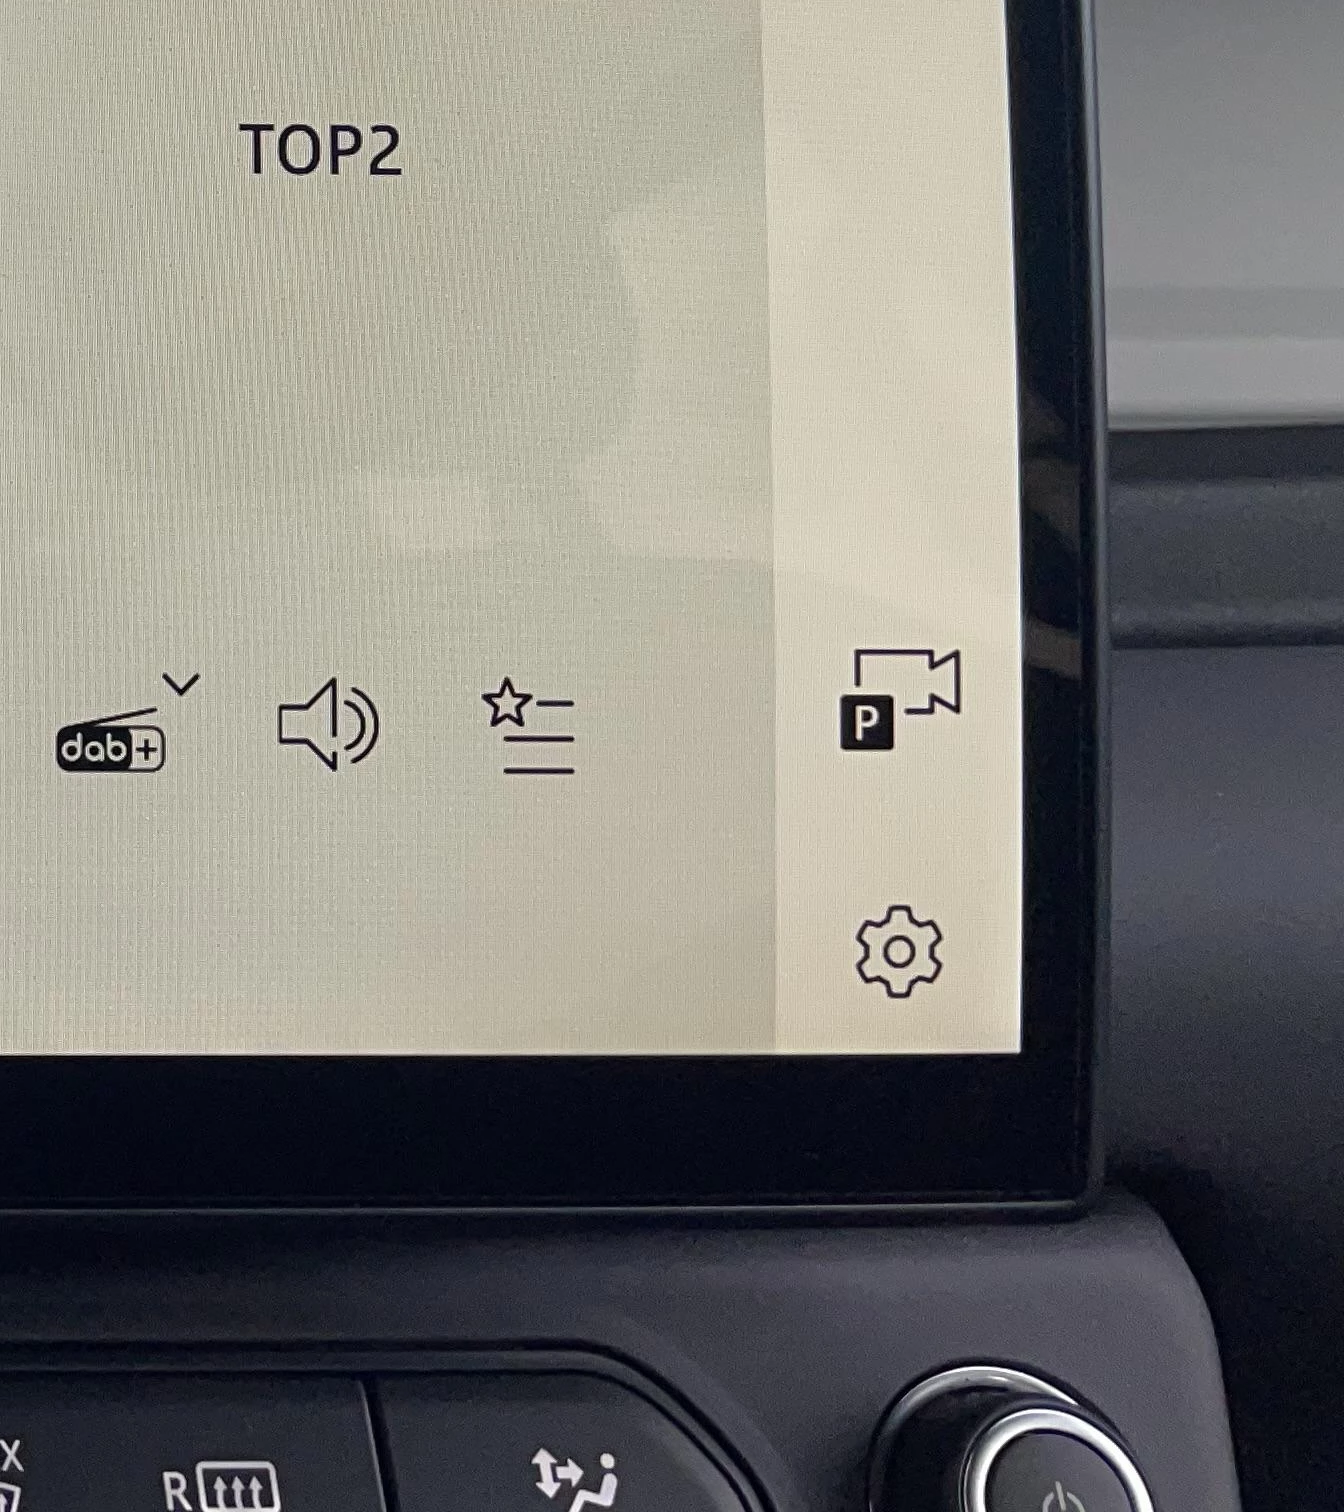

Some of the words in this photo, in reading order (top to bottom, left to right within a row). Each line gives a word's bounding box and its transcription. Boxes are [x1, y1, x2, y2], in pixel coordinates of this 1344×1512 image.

[238, 123, 403, 176] TOP2
[854, 704, 880, 742] P
[162, 1471, 193, 1512] R
